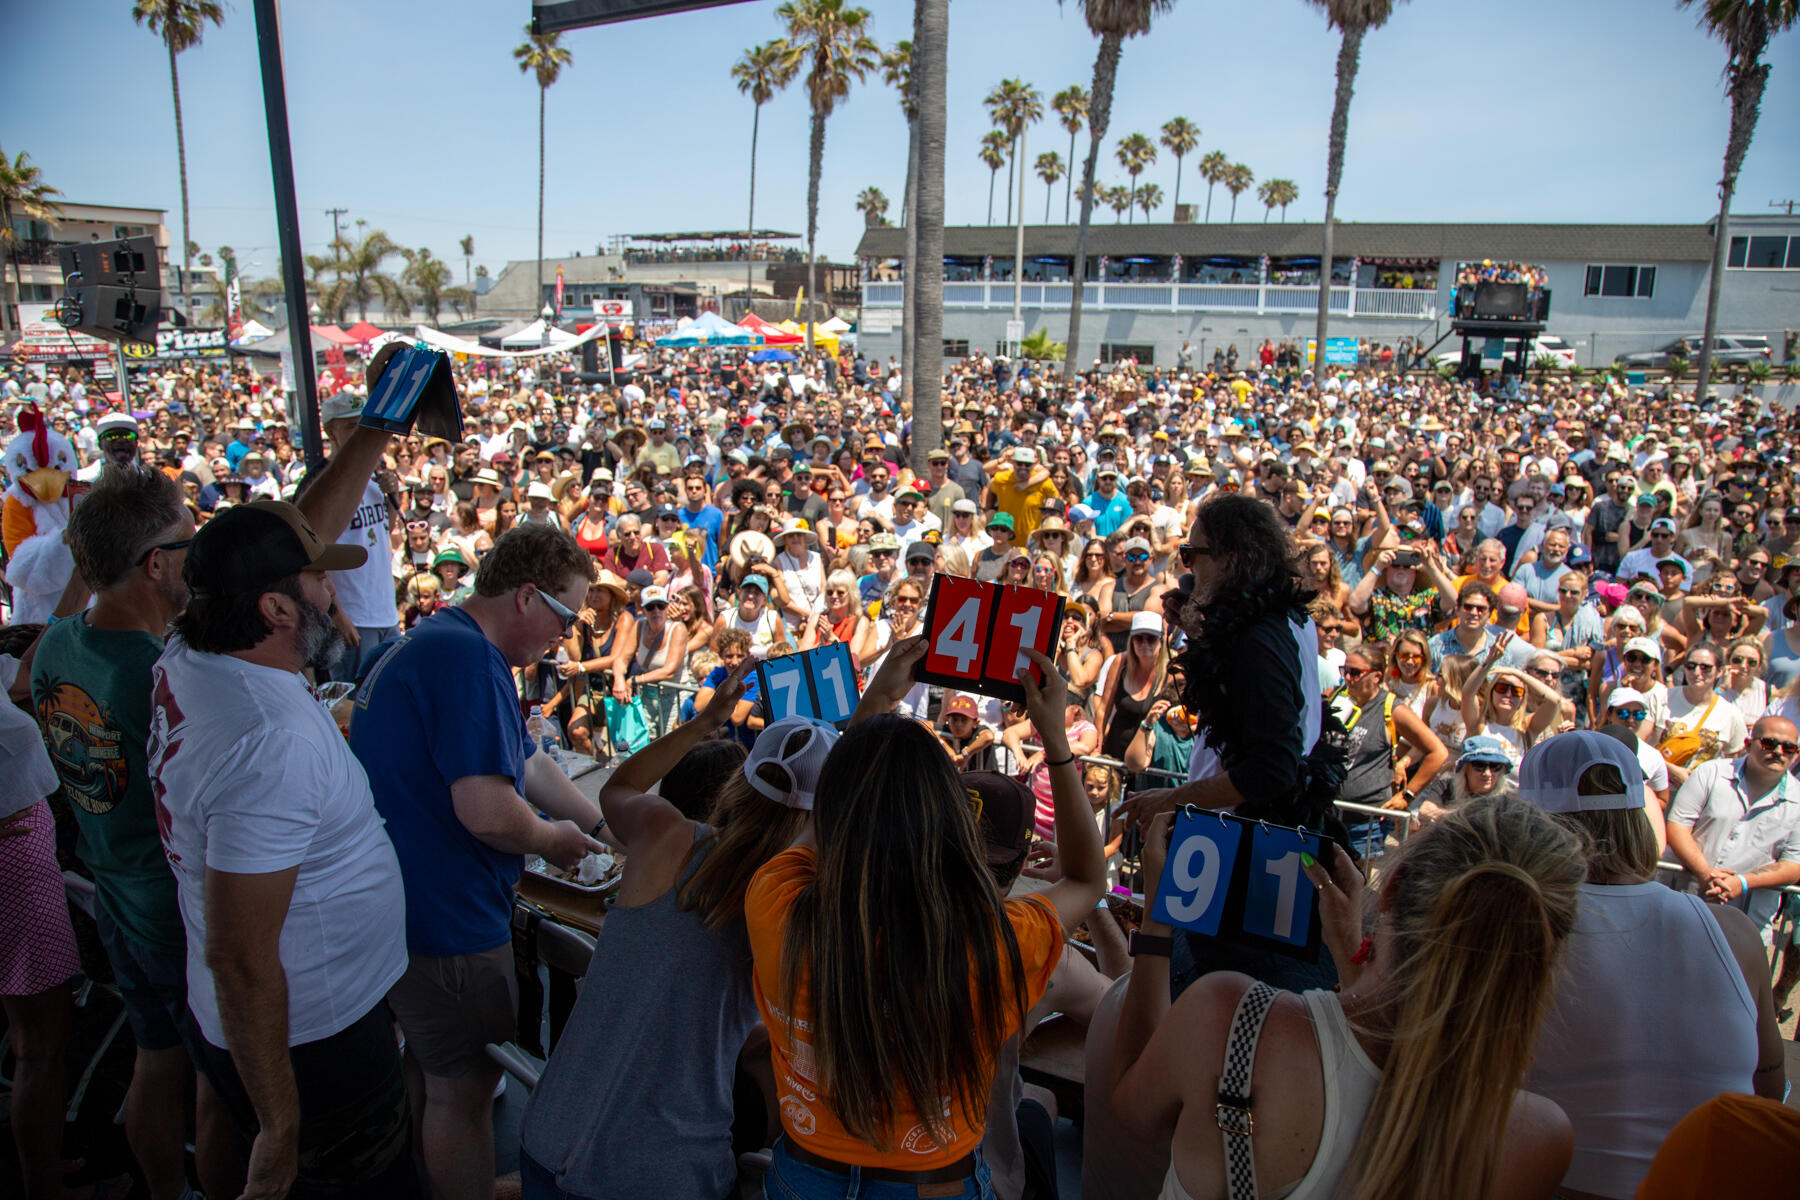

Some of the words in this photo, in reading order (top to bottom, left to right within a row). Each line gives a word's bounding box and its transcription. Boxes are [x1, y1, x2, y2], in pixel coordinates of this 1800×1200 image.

[156, 330, 226, 351] Pizza
[374, 360, 430, 419] 11
[935, 597, 1043, 680] 41
[770, 657, 850, 717] 71
[89, 725, 121, 741] NEWPORT
[1165, 834, 1300, 939] 91
